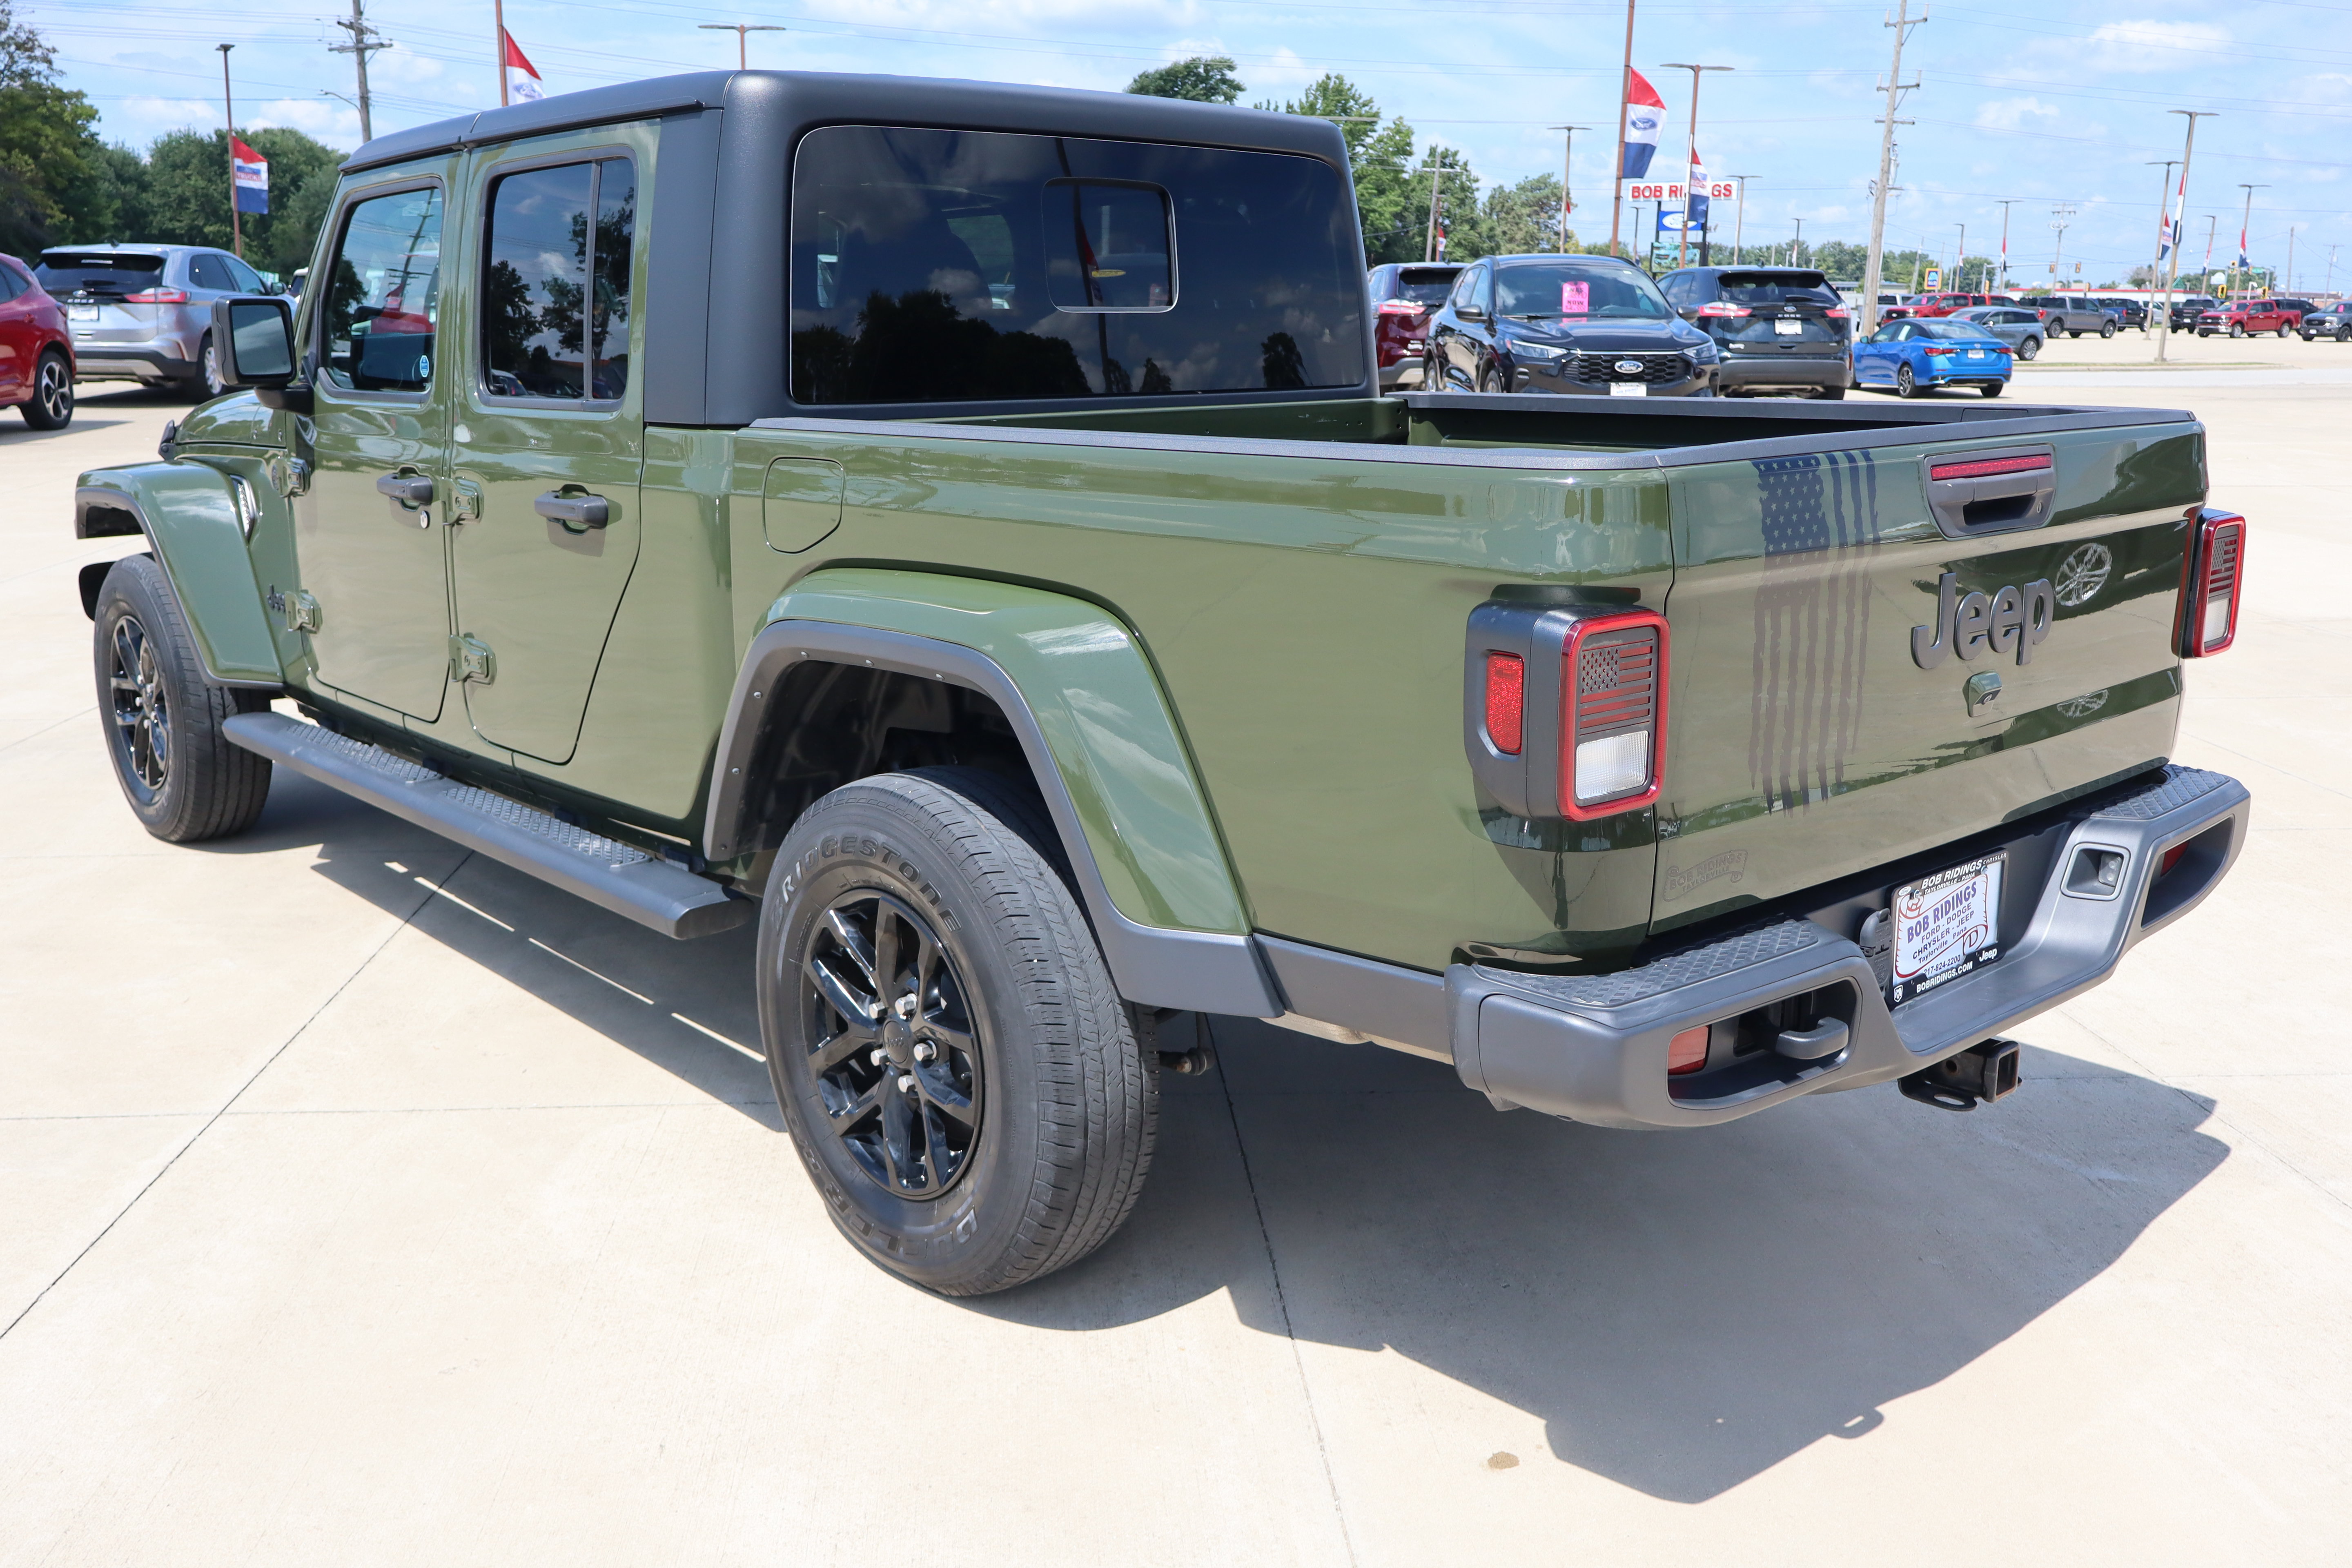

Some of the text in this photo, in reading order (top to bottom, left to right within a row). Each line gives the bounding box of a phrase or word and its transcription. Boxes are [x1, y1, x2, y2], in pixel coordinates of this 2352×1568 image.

[1632, 184, 1732, 198] BOB RIGS
[1910, 572, 2054, 670] Jeep
[1669, 852, 1742, 891] BOB RIDINGS
[1921, 853, 2007, 889] BOB RIDINGS CHRYSLER
[1924, 878, 1957, 895] TAYLORVILLE
[1961, 872, 1975, 882] PANA
[1907, 881, 1978, 944] BOB RIDINGS
[1921, 927, 1940, 944] FORD
[1947, 902, 1972, 925] DODGE
[1913, 927, 1950, 960] CHRYSLER
[1956, 910, 1975, 928] JEEP
[1918, 926, 1967, 964] Taylorville Pana
[1924, 954, 1960, 975] 217-824-2200
[1979, 948, 1997, 962] Jeep
[1916, 961, 1973, 993] BOBRIDINGS.COM
